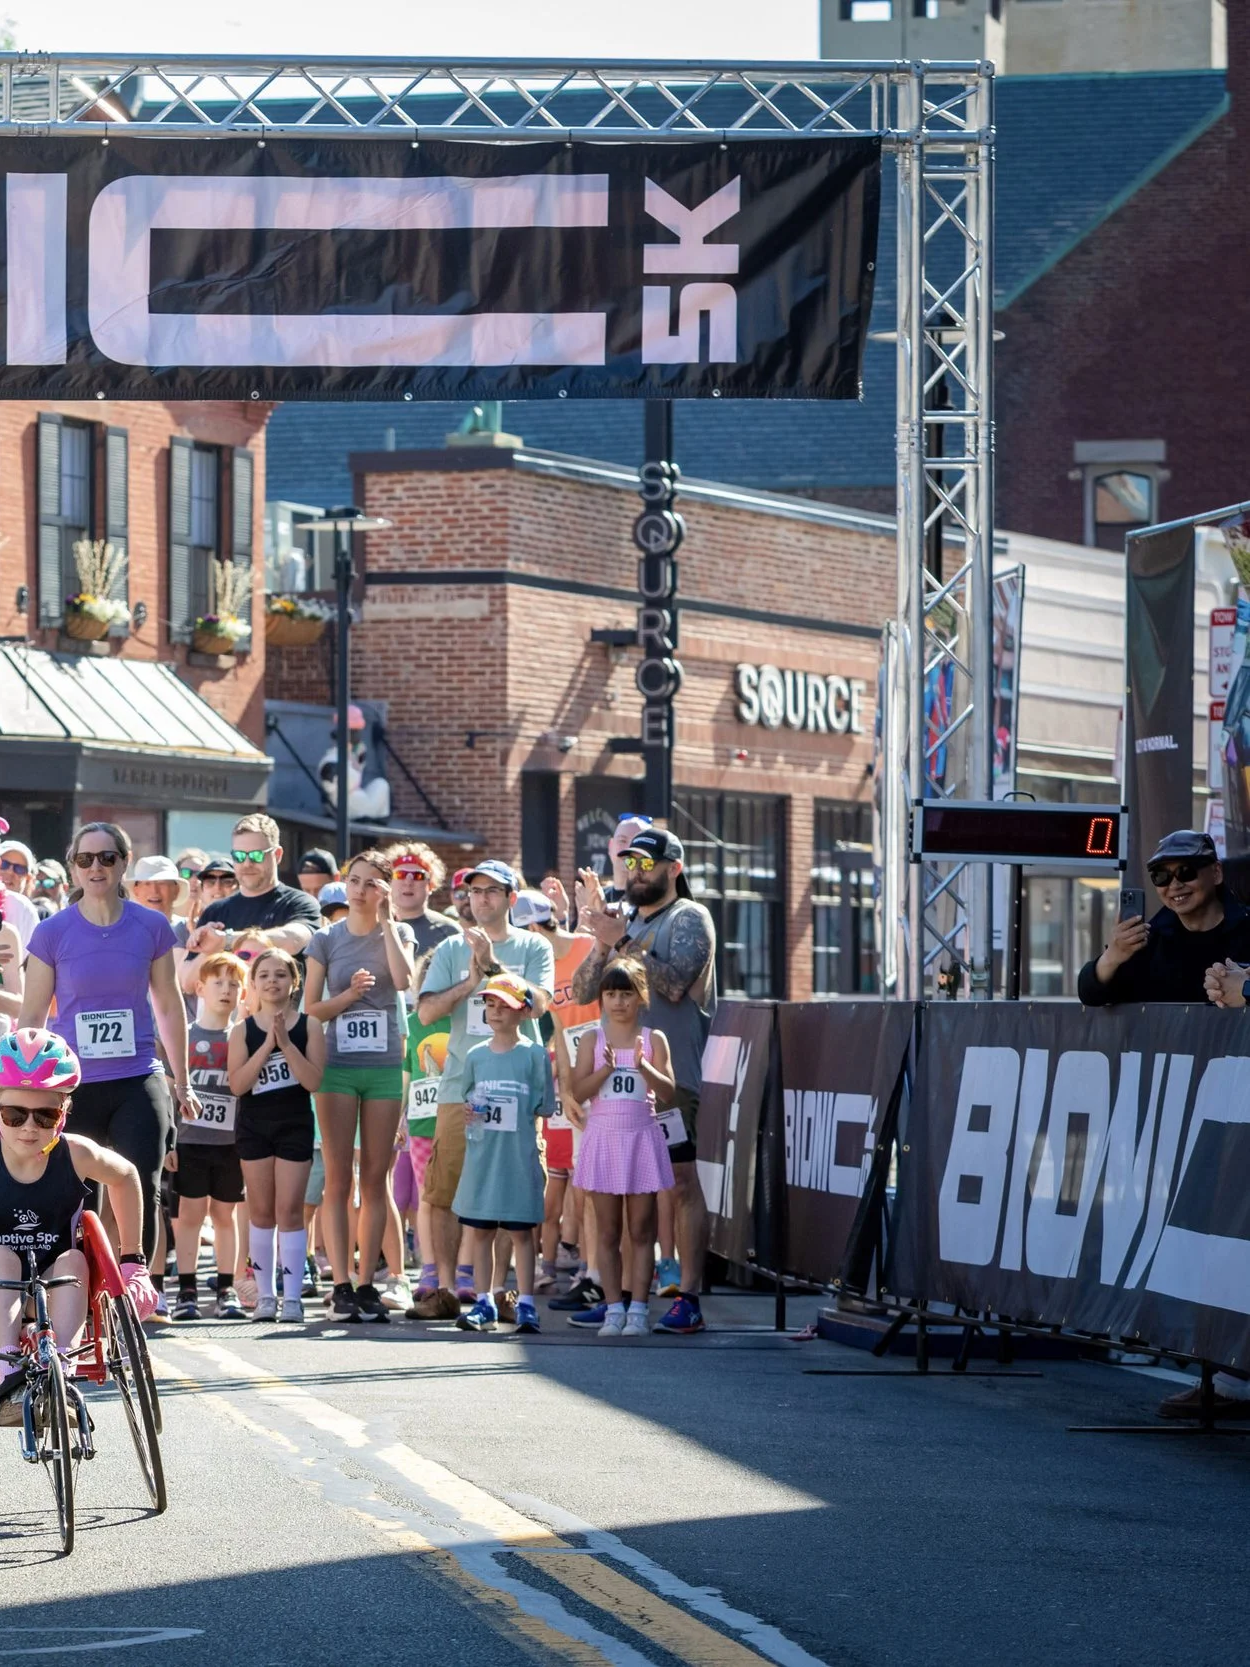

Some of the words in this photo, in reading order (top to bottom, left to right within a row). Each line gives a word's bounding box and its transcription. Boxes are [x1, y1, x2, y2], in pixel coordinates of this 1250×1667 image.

[642, 173, 741, 364] 5K
[82, 1011, 121, 1021] BIONIC
[89, 1021, 123, 1044] 722
[347, 1020, 378, 1039] 981
[258, 1062, 291, 1086] 958
[612, 1075, 636, 1094] 80
[414, 1087, 438, 1106] 942
[197, 1103, 227, 1124] 33
[783, 1088, 872, 1197] BIONIC
[19, 1243, 51, 1251] ENGLAND
